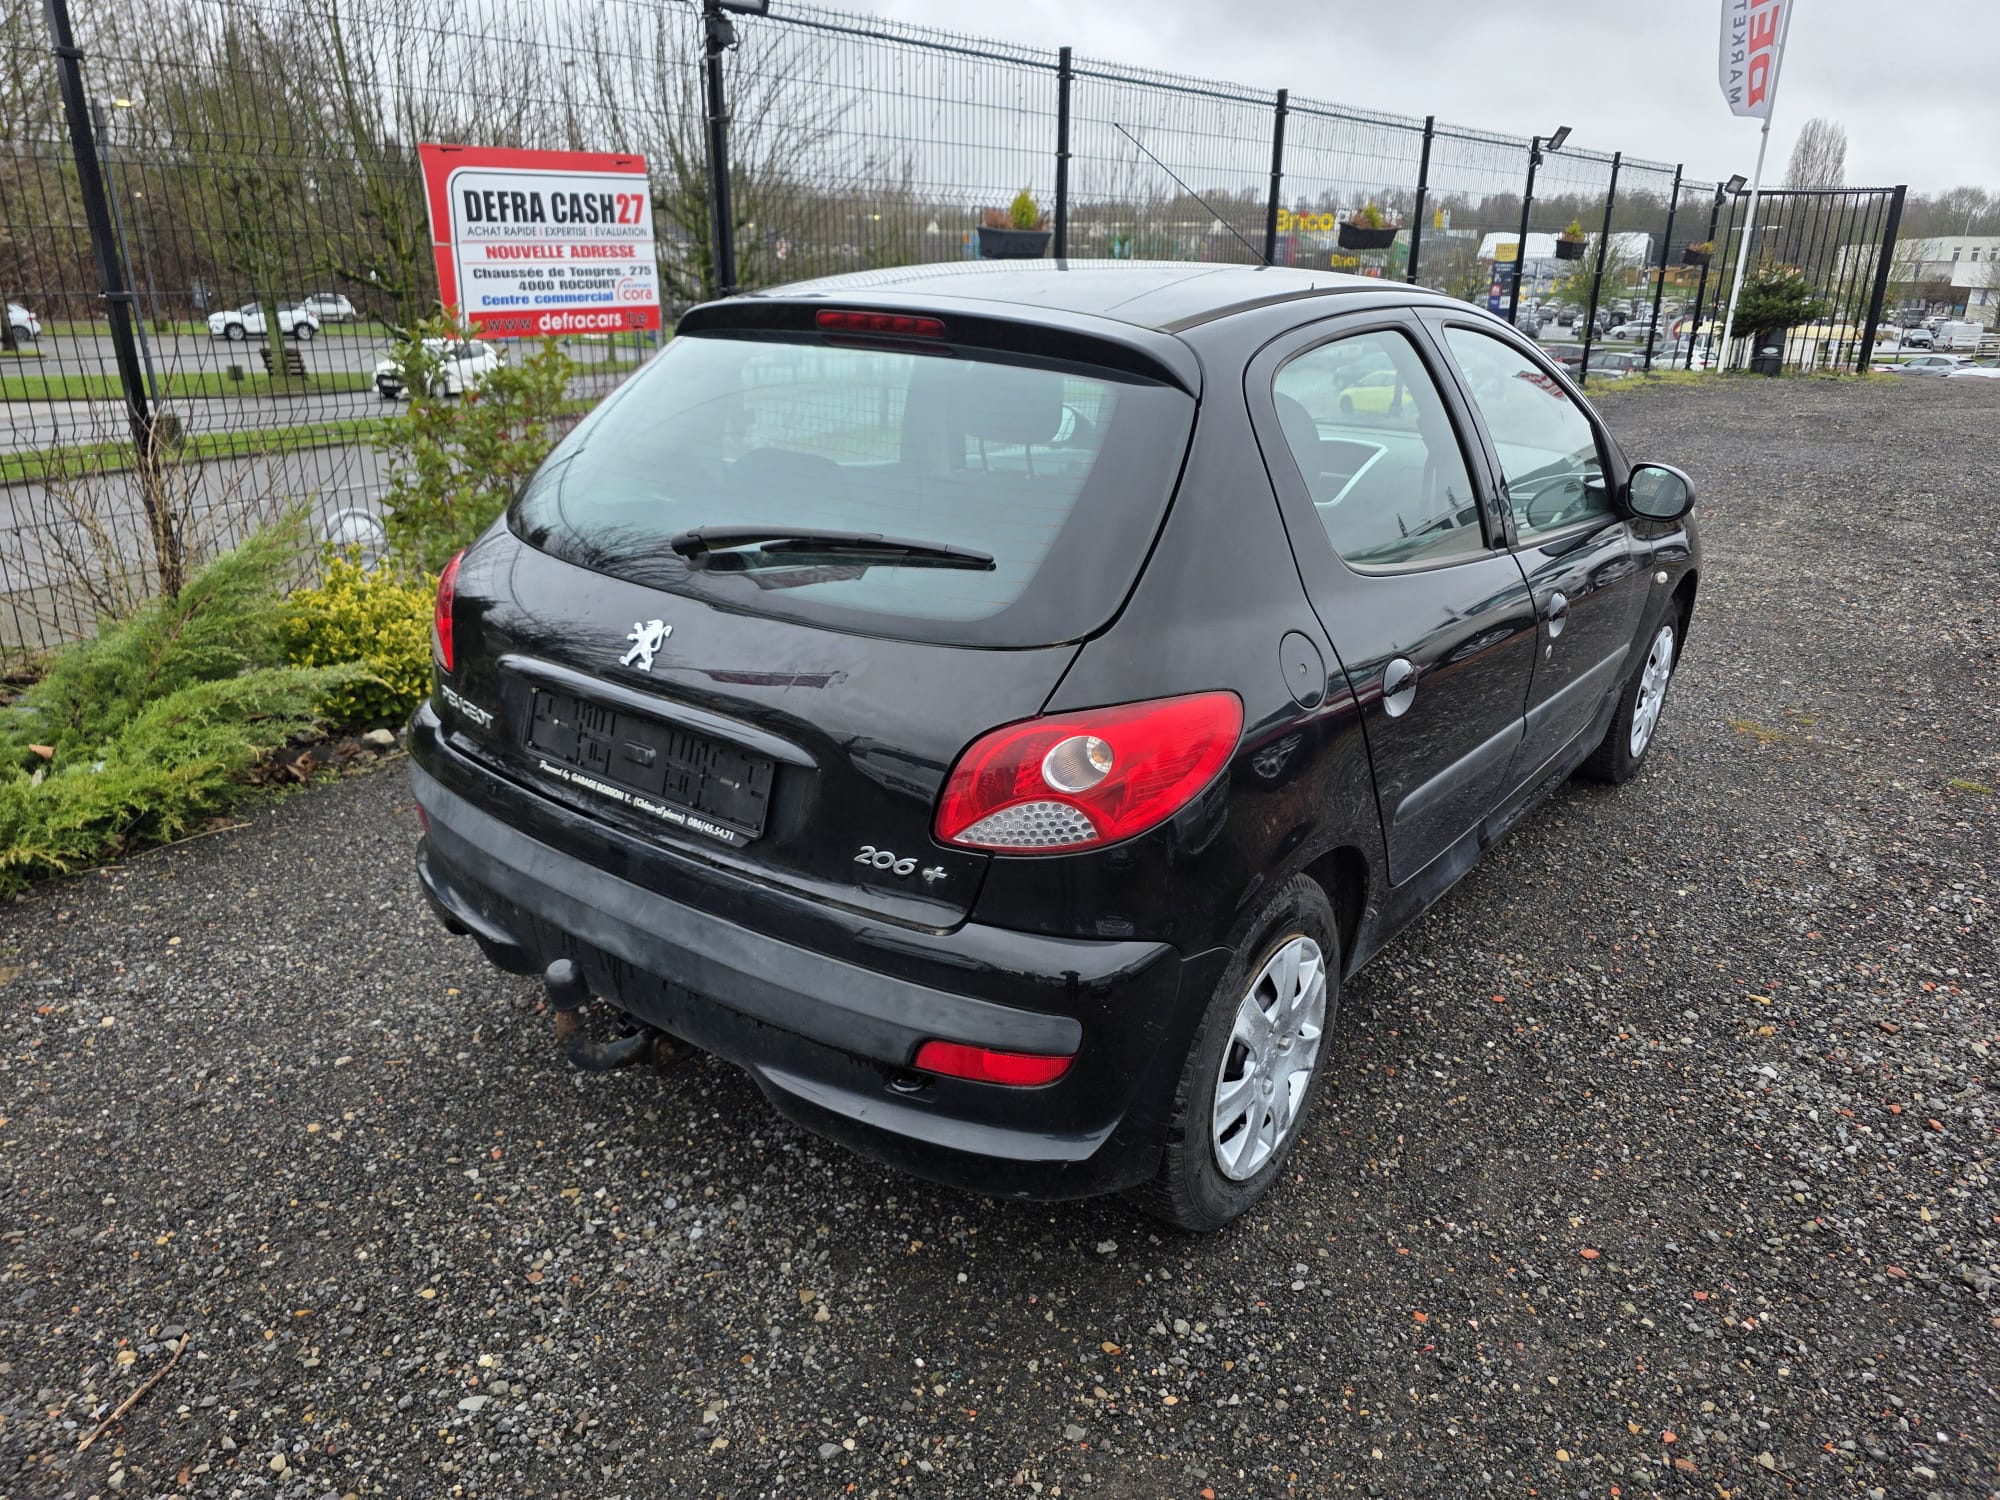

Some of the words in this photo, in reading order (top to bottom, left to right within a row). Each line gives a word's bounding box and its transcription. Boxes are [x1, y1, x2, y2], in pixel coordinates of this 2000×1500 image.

[463, 190, 546, 223] DEFRA
[467, 226, 502, 237] ACHAT
[504, 226, 537, 237] RAPIDE
[545, 227, 588, 237] EXPERTISE
[485, 245, 564, 259] NOUVELLE
[570, 245, 636, 258] ADRESSE
[473, 266, 544, 279] Chaussée
[548, 267, 565, 277] de
[629, 266, 651, 276] 275
[518, 280, 555, 291] 4000
[560, 279, 616, 290] ROCOURT
[481, 295, 530, 306] Centre
[534, 292, 614, 304] commercial
[624, 289, 652, 301] cora
[441, 684, 494, 729] PEUGEOT
[571, 773, 597, 789] GARAGE
[854, 845, 918, 876] 206
